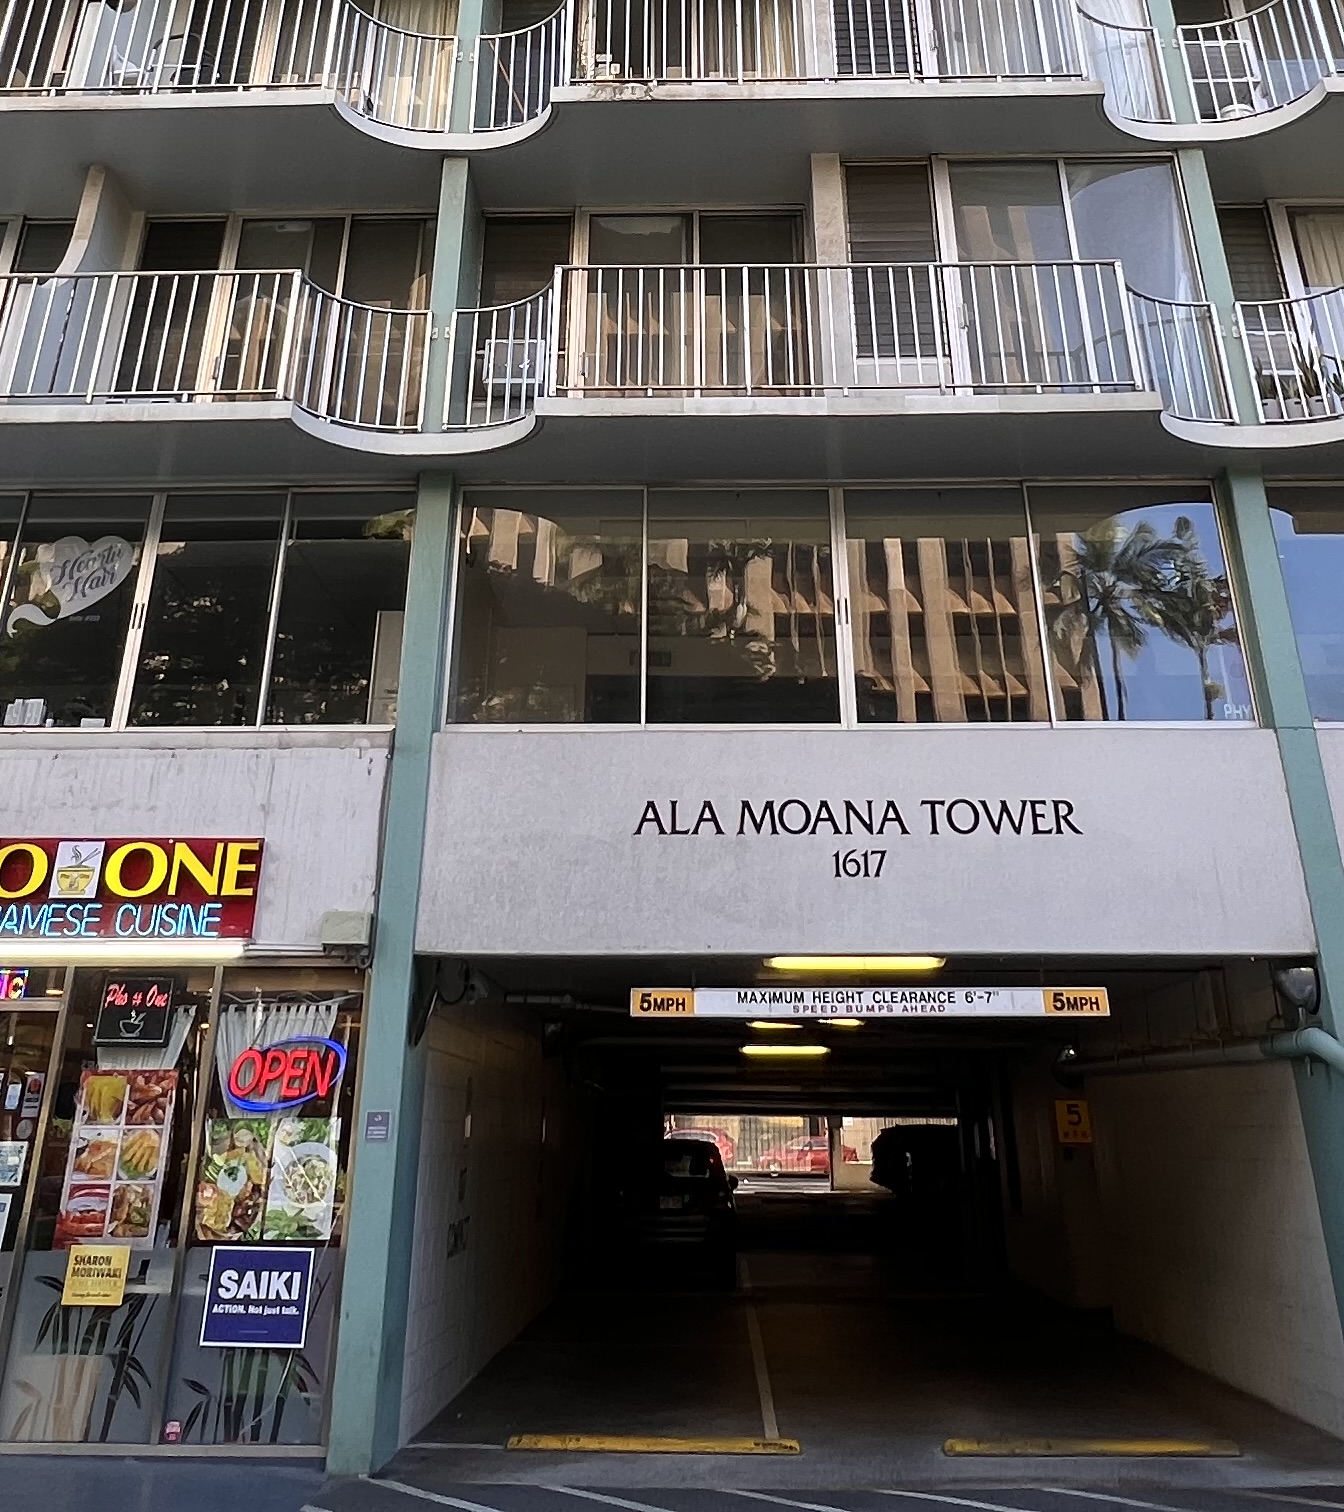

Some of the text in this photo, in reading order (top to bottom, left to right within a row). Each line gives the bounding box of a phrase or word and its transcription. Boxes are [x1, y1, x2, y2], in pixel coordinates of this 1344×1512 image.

[633, 799, 1084, 835] ALA MOANA TOWER
[104, 841, 261, 898] ONE
[832, 849, 887, 878] 1617
[115, 903, 223, 937] CUISINE
[737, 991, 805, 1004] MAXIMUM
[812, 991, 864, 1004] HEIGHT
[872, 991, 956, 1004] CLEARANCE
[792, 1004, 946, 1014] SPEED BUMPS AHEAD
[229, 1048, 336, 1098] OPEN
[1066, 1103, 1082, 1126] 5
[71, 1266, 122, 1279] MORIWAKI
[73, 1254, 113, 1266] SHARON
[218, 1269, 302, 1300] SAIKI
[212, 1303, 247, 1314] ACTION.
